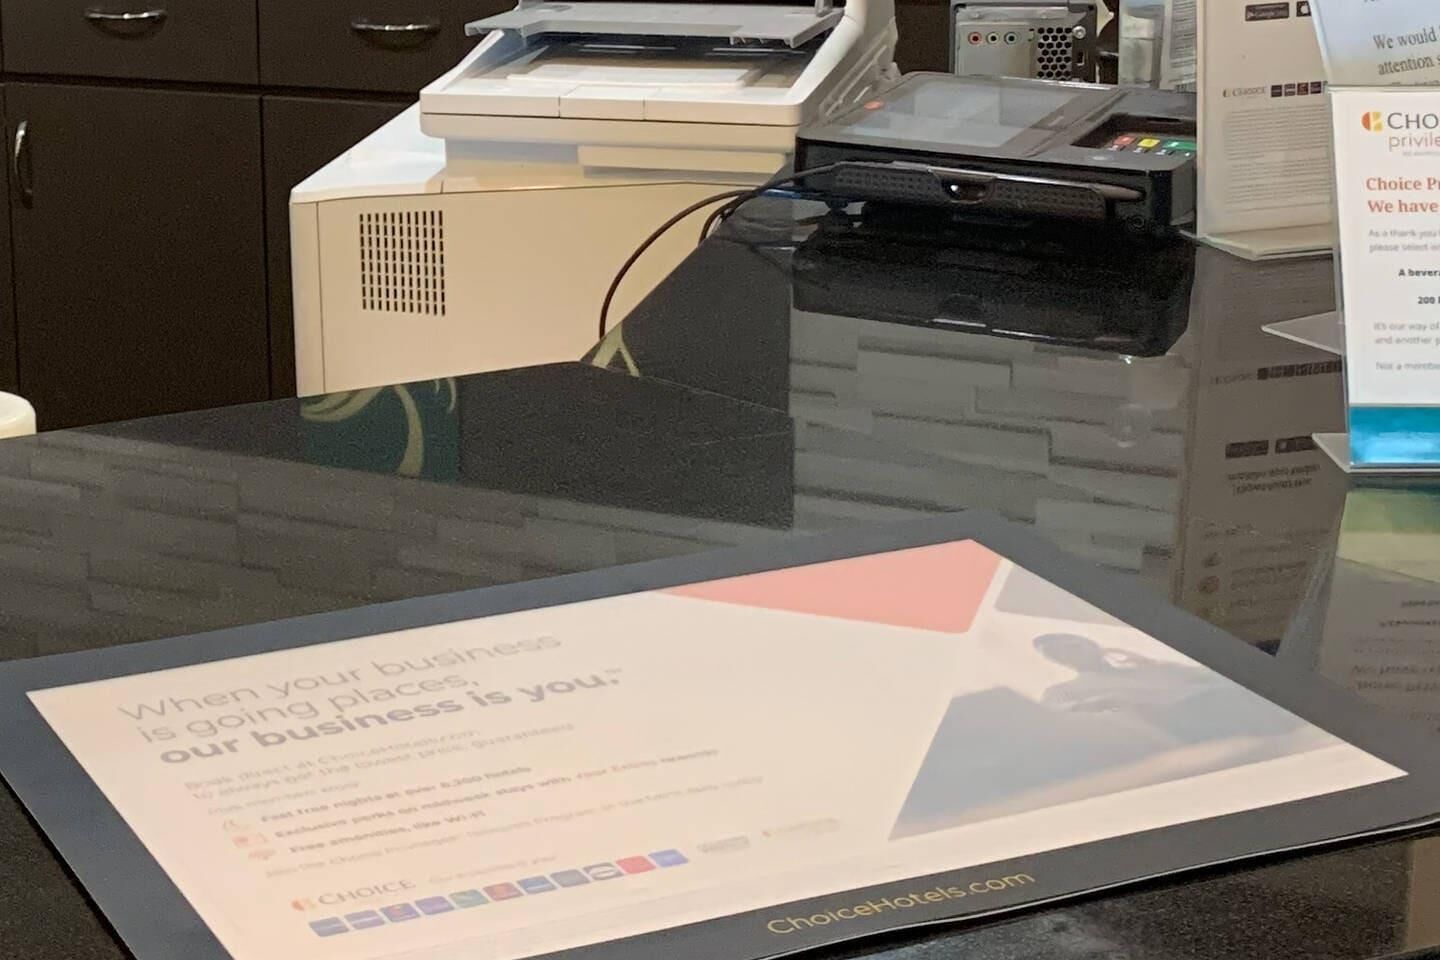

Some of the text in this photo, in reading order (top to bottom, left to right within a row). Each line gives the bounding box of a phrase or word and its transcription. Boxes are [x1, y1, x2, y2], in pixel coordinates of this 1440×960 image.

[1373, 26, 1437, 51] We would
[1378, 56, 1436, 76] attention
[1387, 112, 1439, 130] CHO
[1366, 177, 1440, 191] Choice P
[1367, 199, 1439, 213] We have
[1398, 268, 1440, 277] A bever
[1418, 296, 1436, 305] 200
[117, 635, 562, 721] When your business
[136, 673, 480, 743] is going places,
[160, 738, 239, 764] our
[250, 699, 465, 748] business
[465, 690, 512, 707] is
[317, 878, 416, 906] CHOICE
[766, 871, 1036, 935] ChoiceHotels.com
